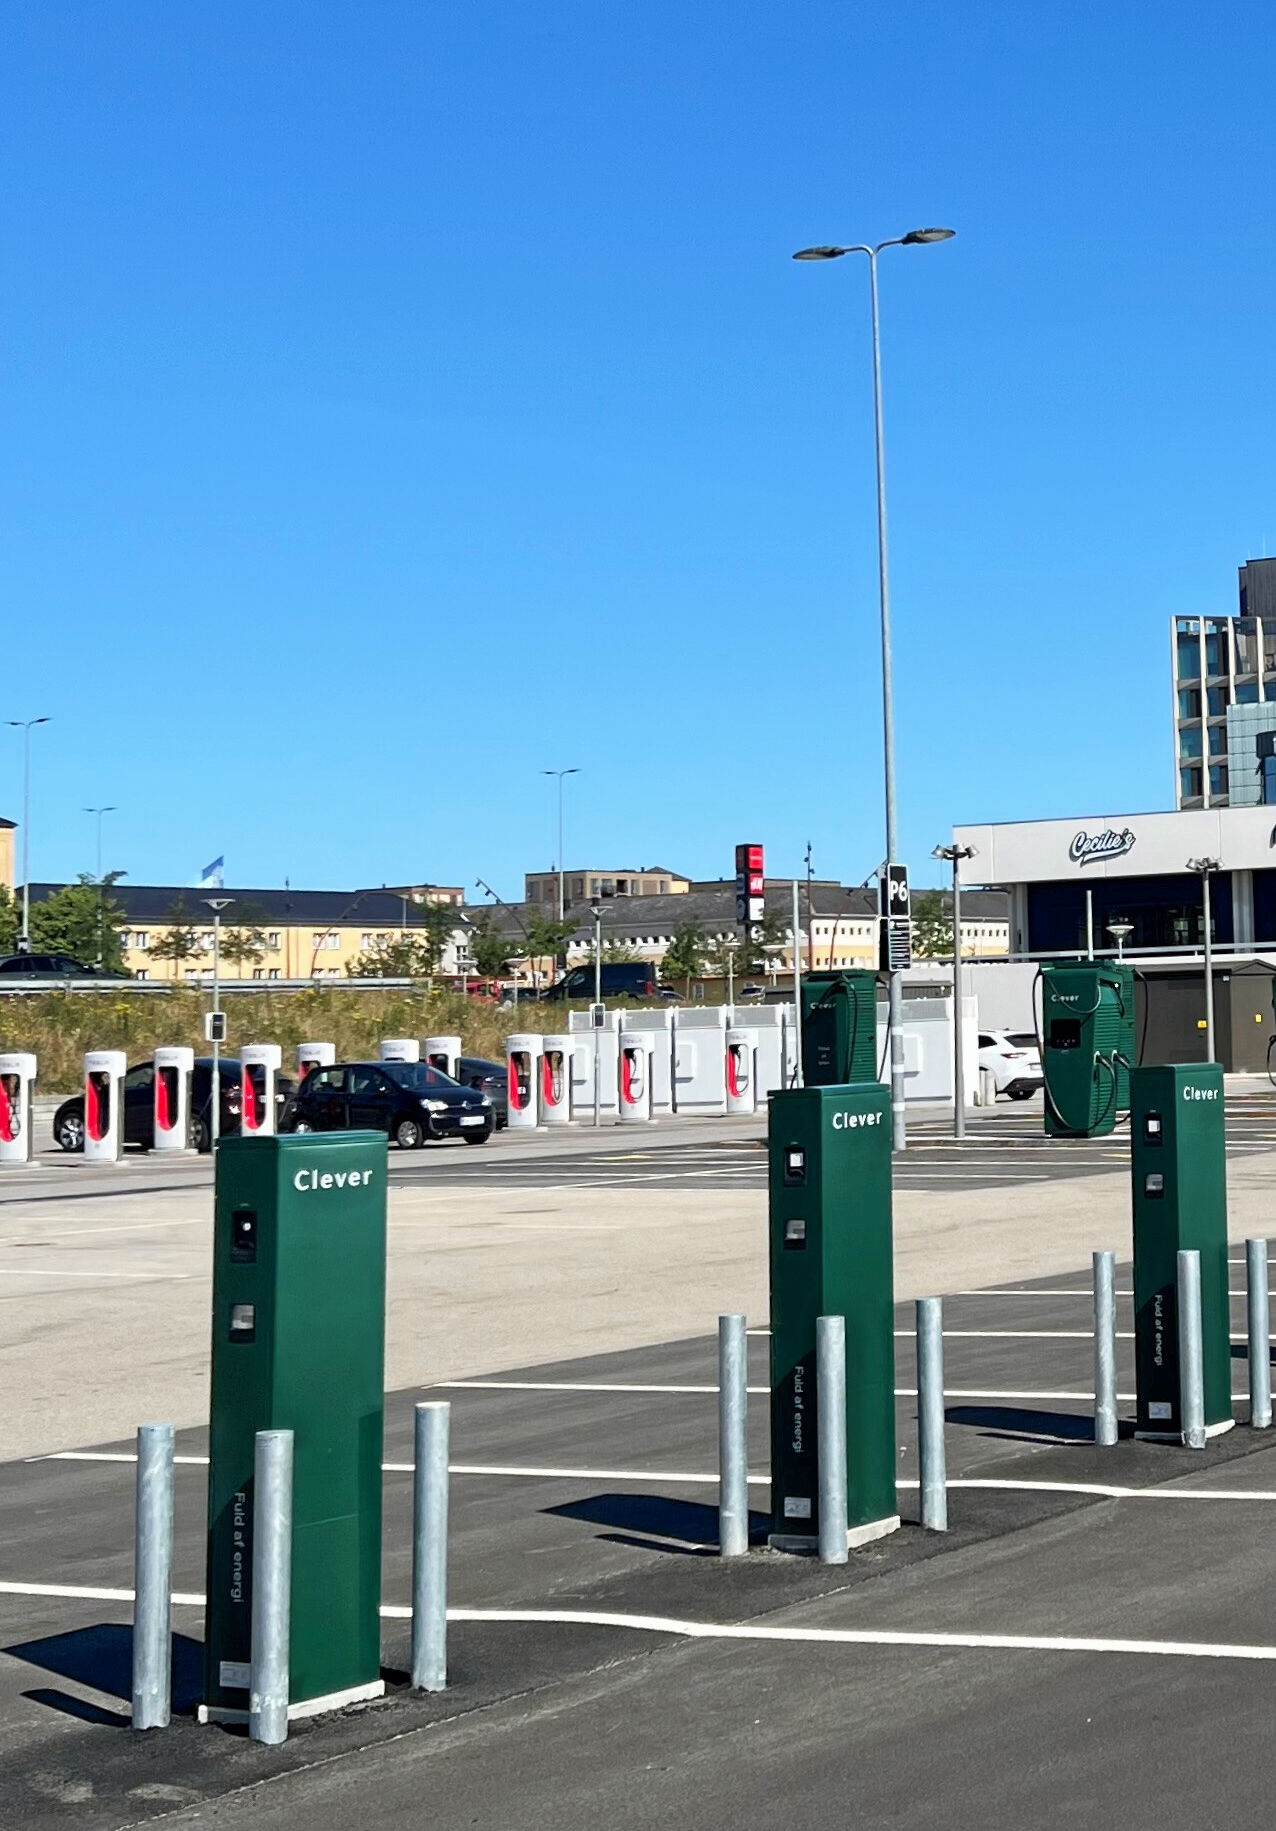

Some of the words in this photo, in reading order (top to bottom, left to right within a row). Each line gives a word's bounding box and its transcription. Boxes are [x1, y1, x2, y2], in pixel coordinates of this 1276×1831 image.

[1069, 828, 1136, 866] Cecilie's
[890, 880, 908, 901] P6
[1183, 1086, 1218, 1100] Clever
[832, 1112, 882, 1129] Clever
[294, 1169, 373, 1191] Clever
[794, 1366, 804, 1393] Fuld
[794, 1396, 804, 1409] af
[792, 1413, 804, 1453] energi
[234, 1492, 246, 1526] Fuld
[233, 1531, 245, 1547] af
[231, 1552, 244, 1602] energi
